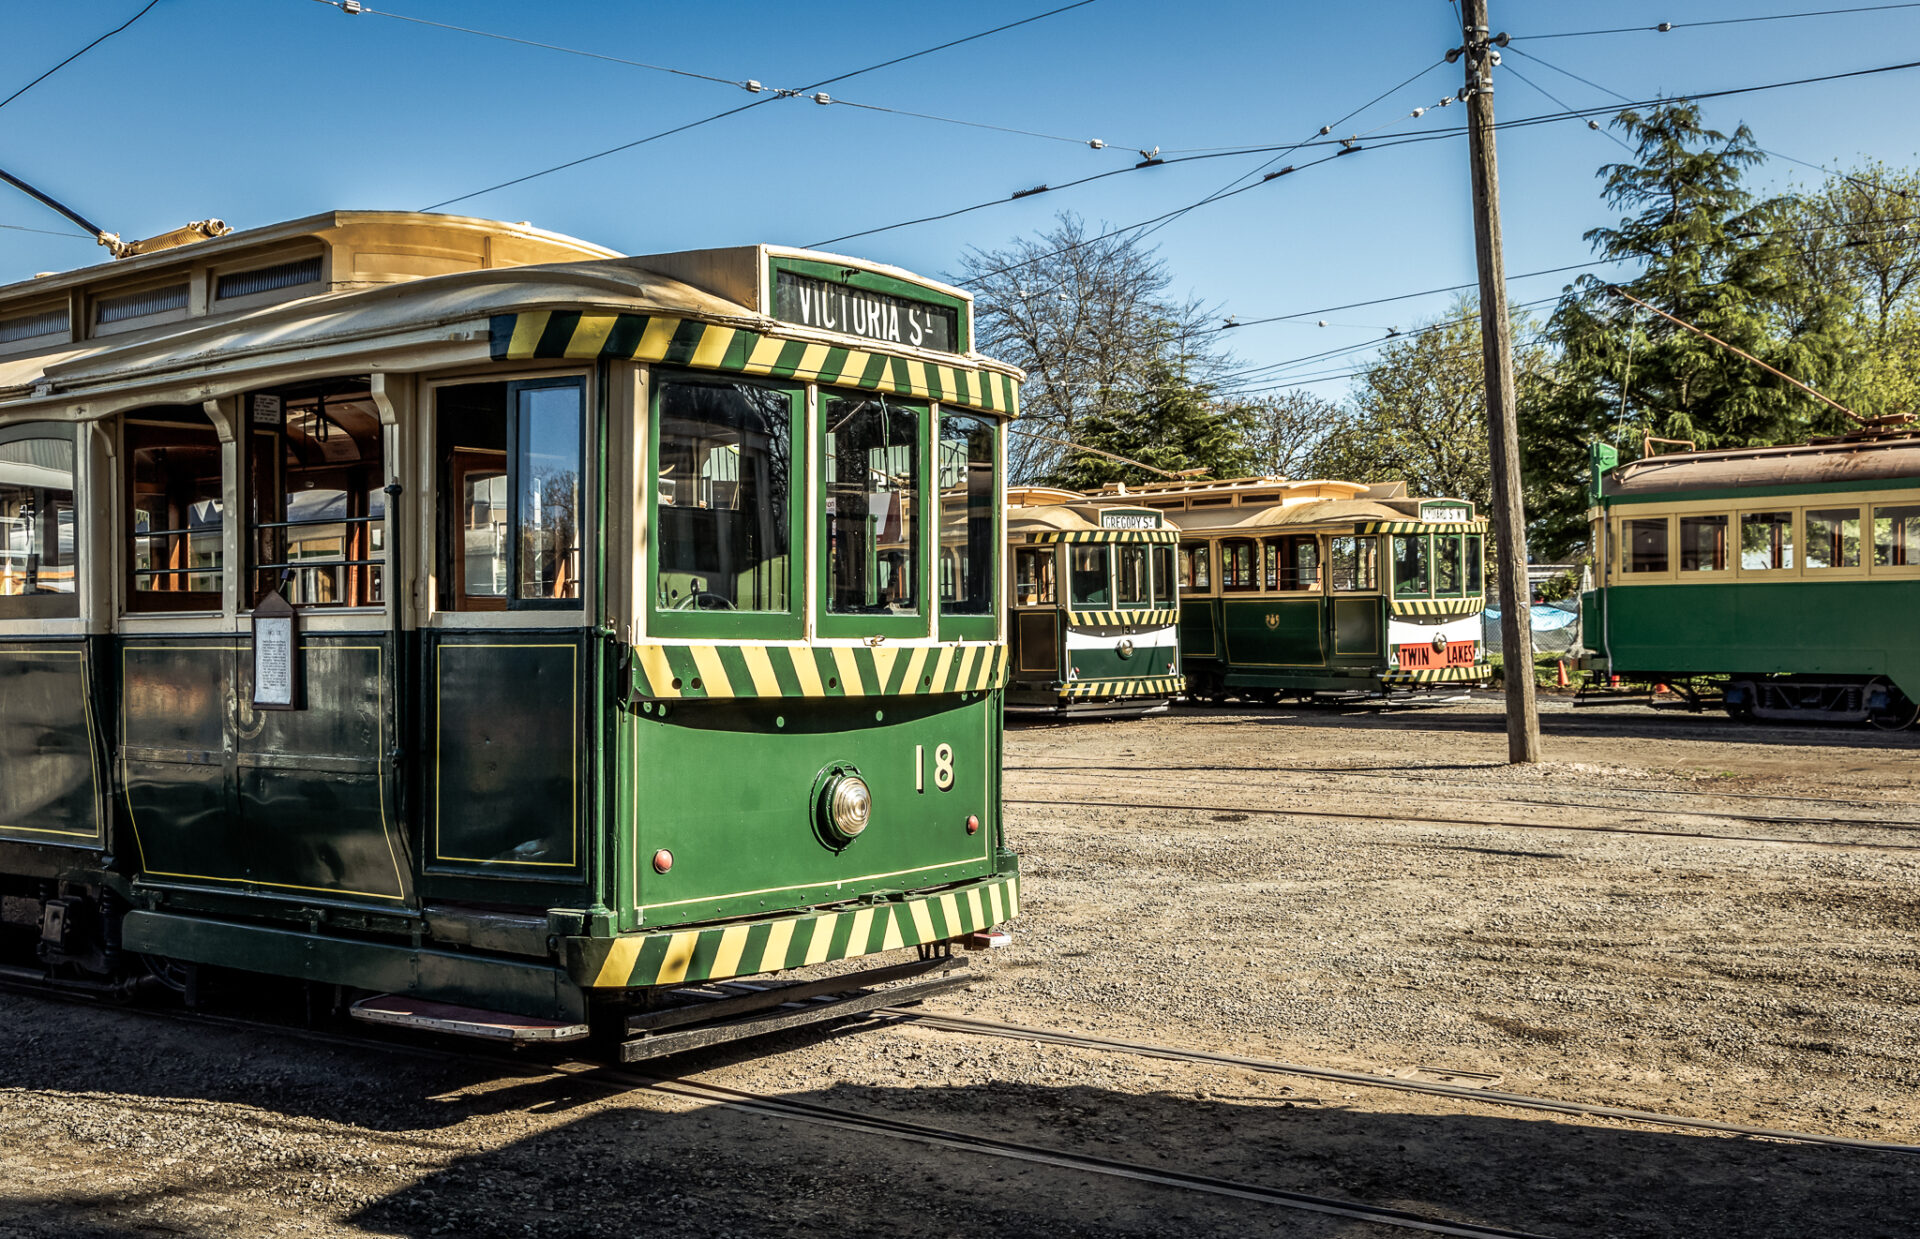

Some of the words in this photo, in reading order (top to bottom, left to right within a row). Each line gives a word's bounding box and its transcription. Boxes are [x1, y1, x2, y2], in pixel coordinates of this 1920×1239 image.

[797, 277, 901, 342] VICTORIA
[1106, 515, 1142, 529] GREGORY
[1121, 625, 1131, 635] 13
[1401, 647, 1430, 667] TWIN
[1446, 644, 1473, 664] LAKES
[915, 742, 955, 793] 18
